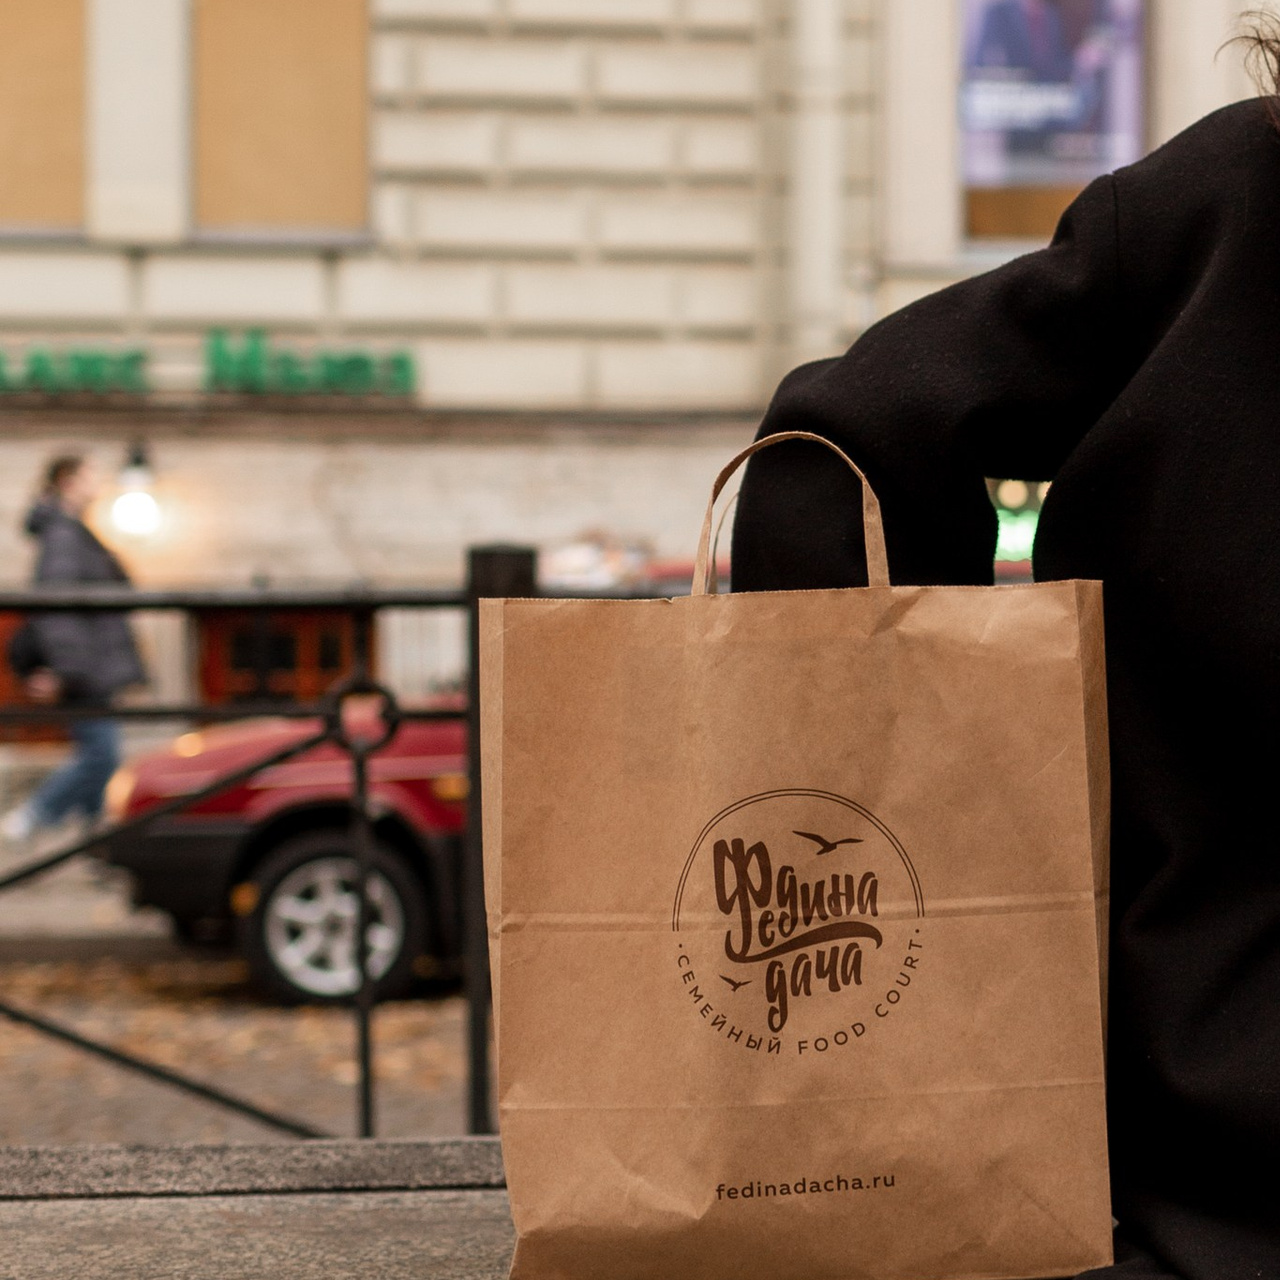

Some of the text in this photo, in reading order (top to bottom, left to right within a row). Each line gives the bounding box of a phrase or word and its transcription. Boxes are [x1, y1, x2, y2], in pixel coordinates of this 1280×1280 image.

[713, 837, 880, 964] Федина
[677, 938, 924, 1055] СЕМЕЙНЫЙ FOOD COURT
[765, 942, 863, 1034] дача
[716, 1175, 896, 1200] fedinadacha.ru
